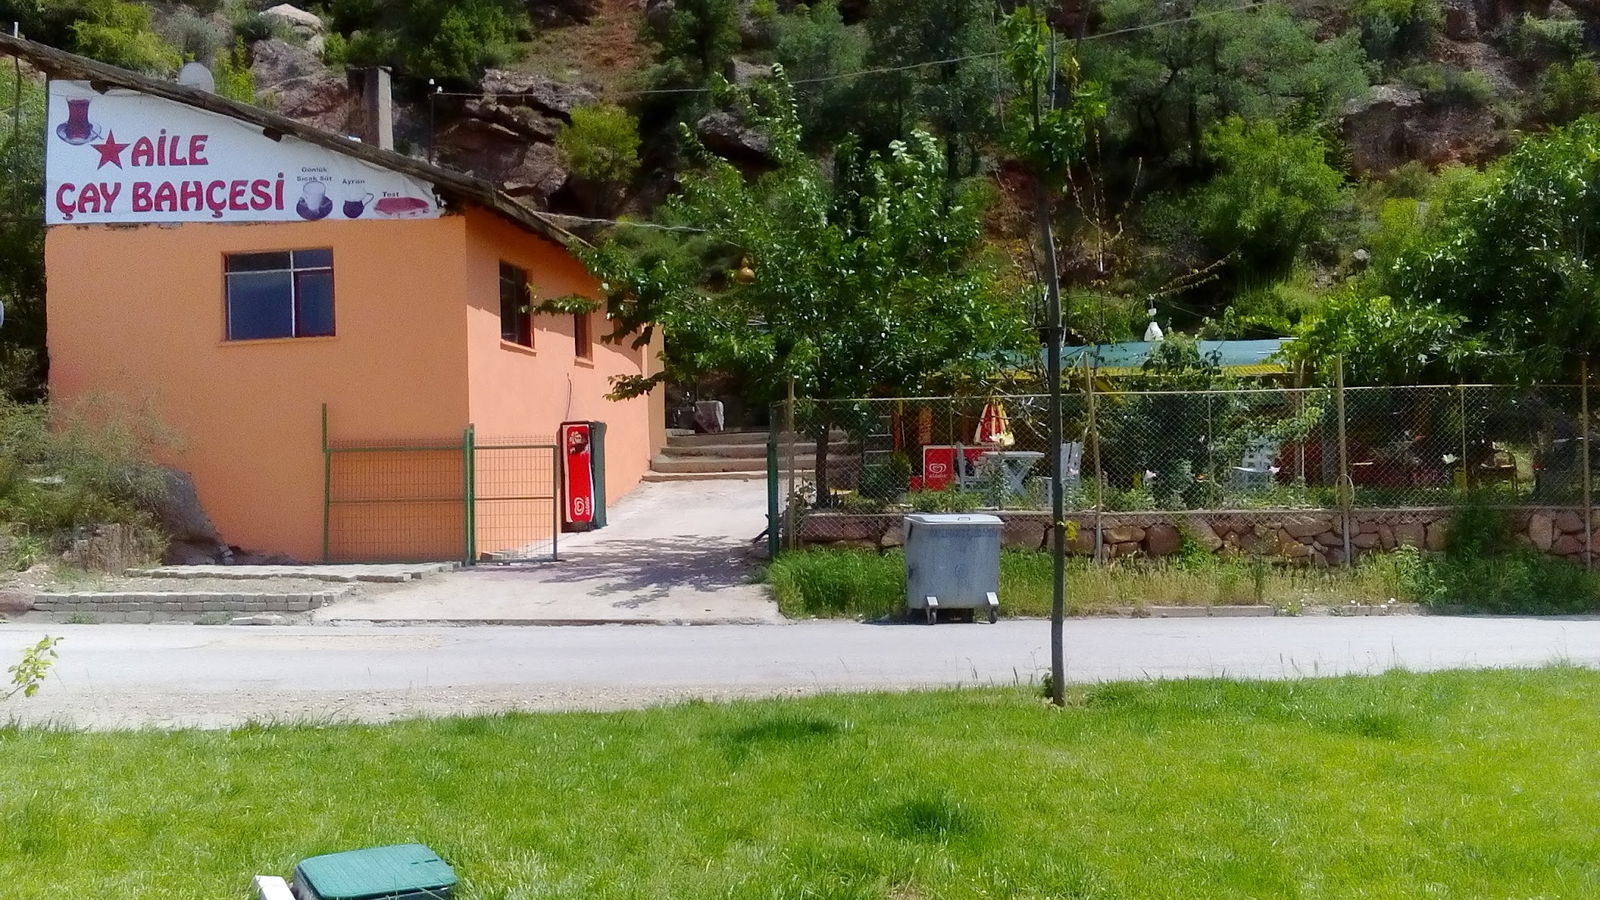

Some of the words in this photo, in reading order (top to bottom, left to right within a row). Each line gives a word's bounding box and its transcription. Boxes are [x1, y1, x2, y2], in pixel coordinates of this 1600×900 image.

[131, 129, 209, 167] AİLE
[56, 182, 122, 220] ÇAY
[132, 172, 285, 218] BAHÇESİ
[342, 178, 366, 186] Ayran
